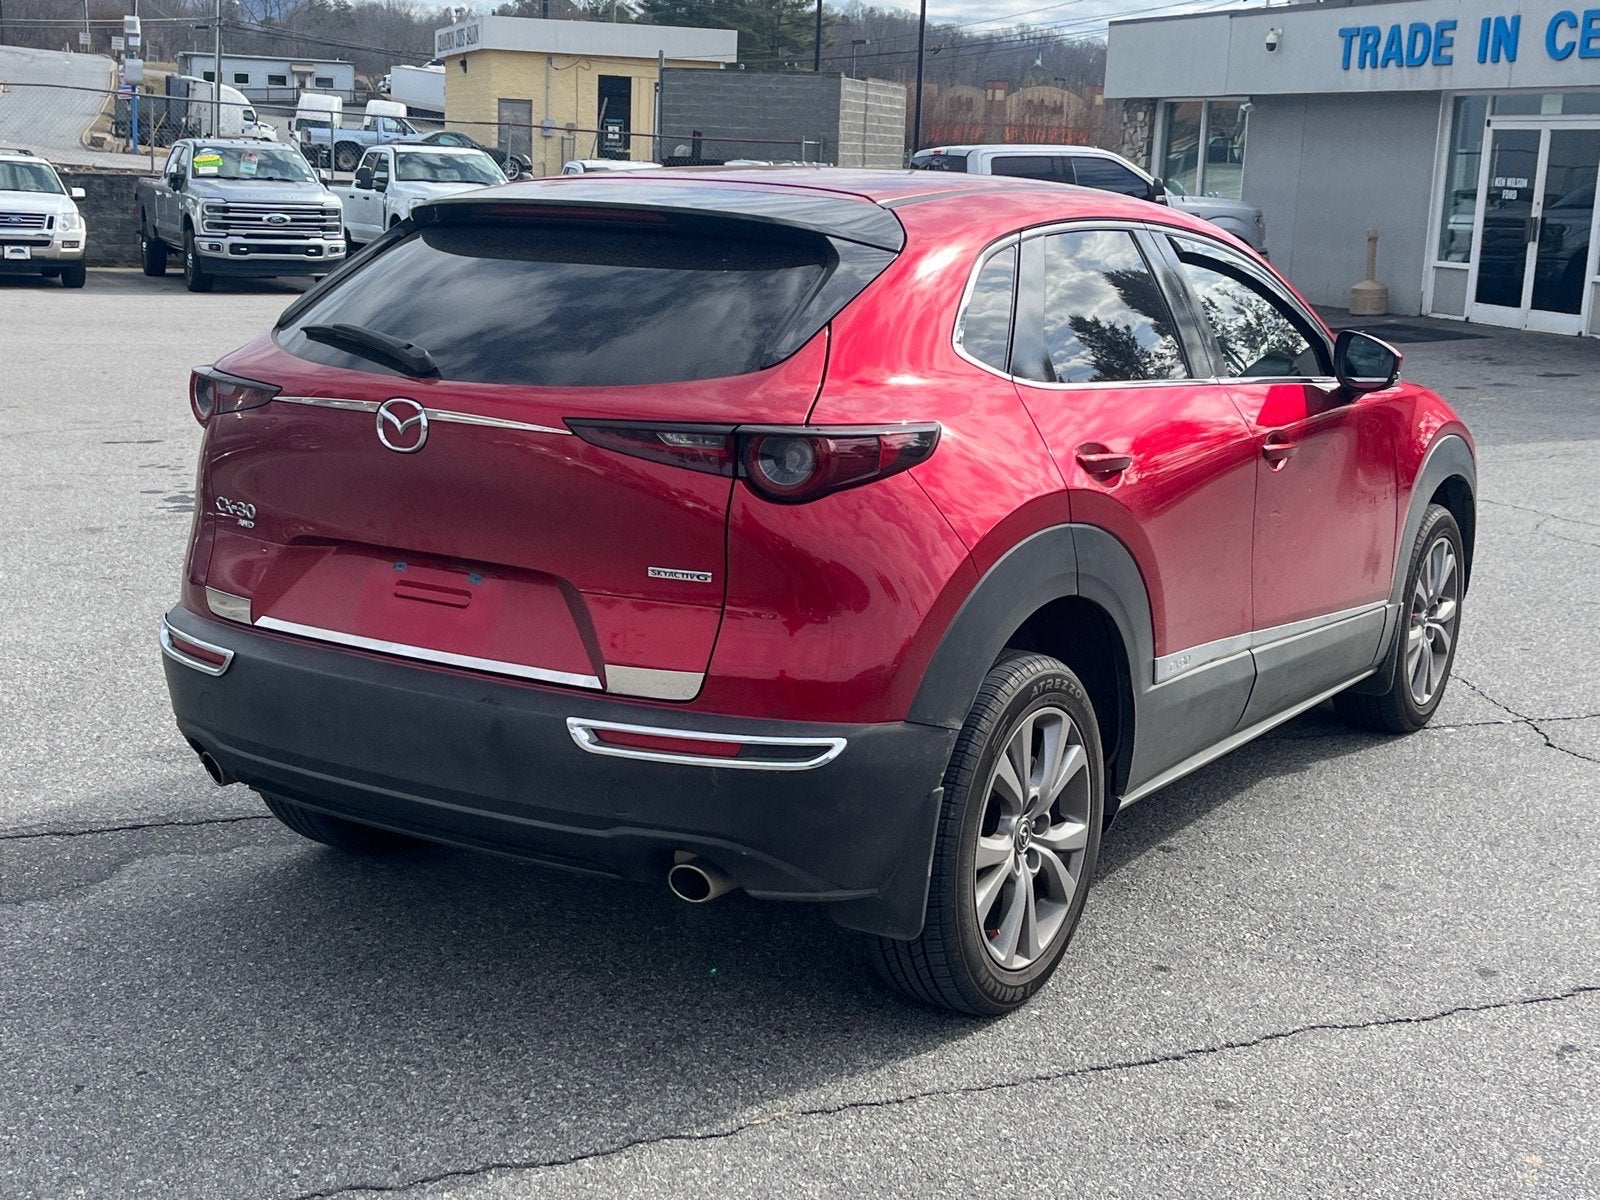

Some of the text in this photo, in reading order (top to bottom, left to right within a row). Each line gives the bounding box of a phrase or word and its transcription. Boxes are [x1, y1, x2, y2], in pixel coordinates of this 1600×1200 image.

[1338, 19, 1458, 70] TRADE
[1477, 14, 1521, 64] IN
[1502, 189, 1518, 200] FORD
[215, 496, 257, 519] CX-30
[237, 518, 255, 529] AWD
[1030, 678, 1082, 700] ATREZZO
